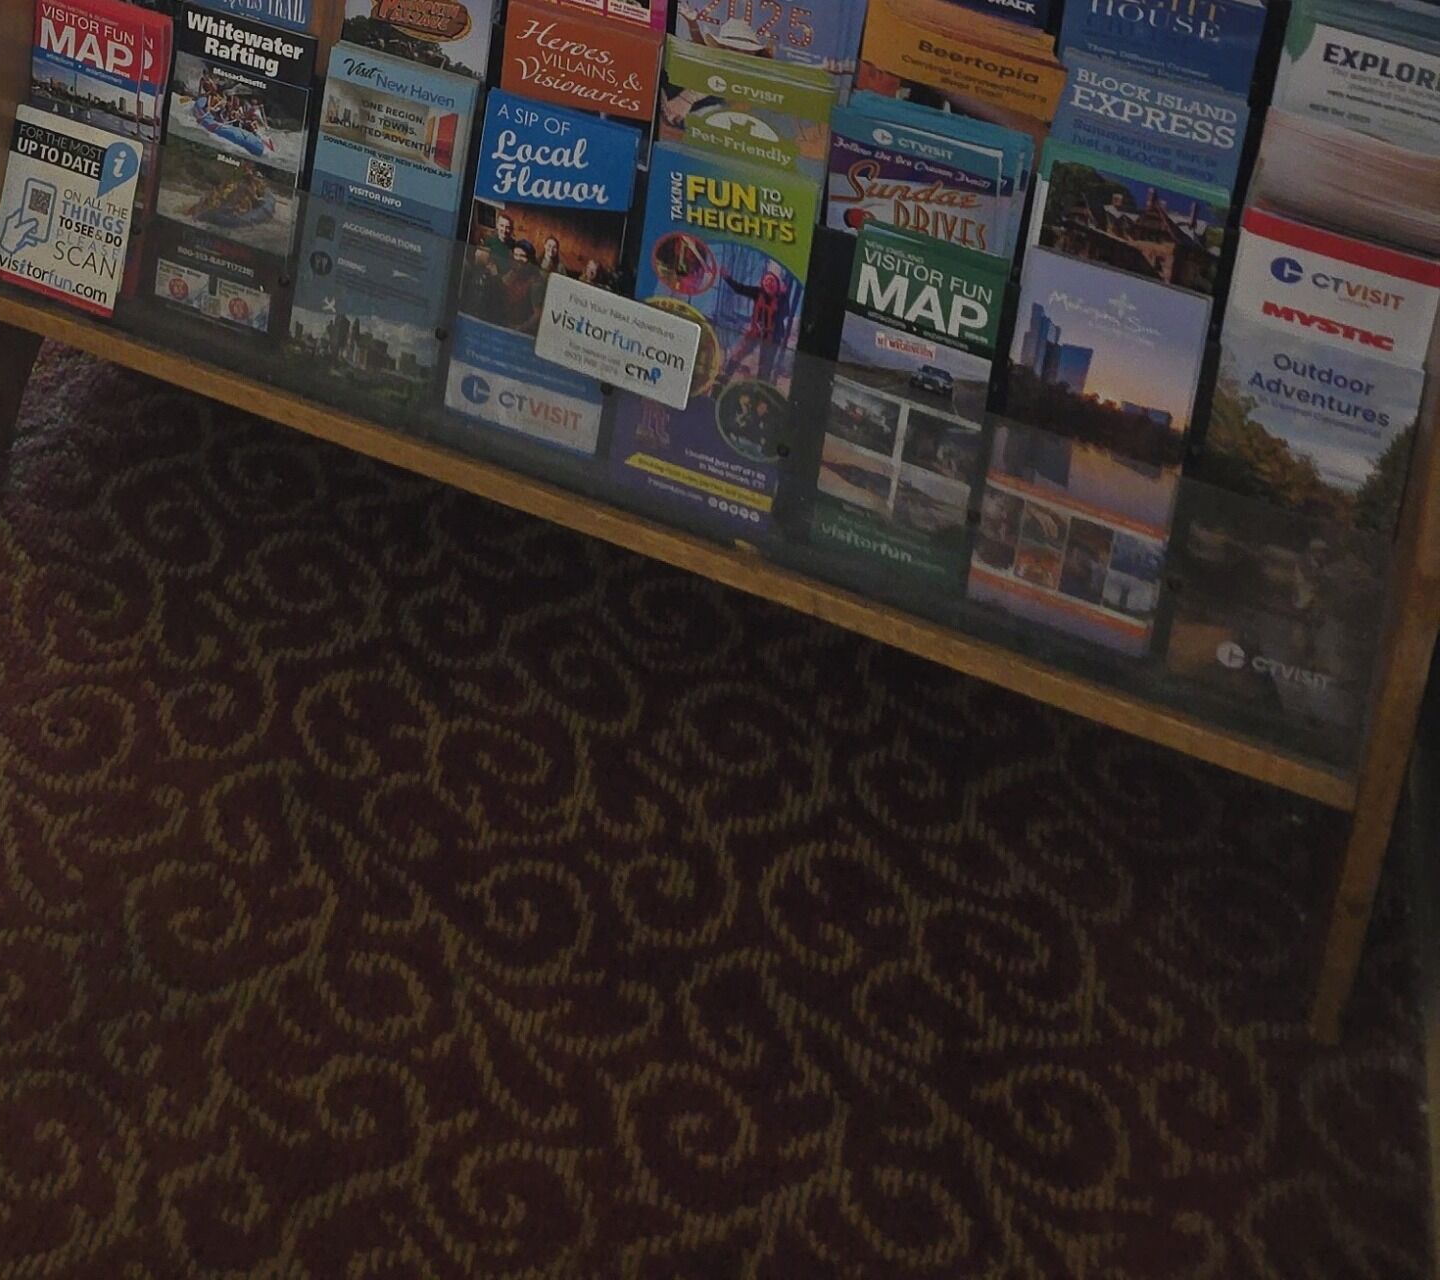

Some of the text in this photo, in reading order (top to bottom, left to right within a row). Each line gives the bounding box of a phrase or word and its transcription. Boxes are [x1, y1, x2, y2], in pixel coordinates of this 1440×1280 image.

[40, 17, 133, 73] MAP
[42, 4, 100, 34] VISITOR
[104, 25, 135, 46] FUN
[186, 10, 304, 62] Whitewater
[516, 18, 615, 65] Heroes,
[204, 37, 280, 78] Rafting
[917, 39, 1039, 84] Beertopia
[514, 56, 641, 113] Visionaries
[1076, 68, 1238, 124] BLOCK ISLAND
[498, 103, 571, 136] A SIP OF
[1070, 84, 1236, 149] EXPRESS
[17, 138, 101, 178] UP TO DATE
[492, 130, 589, 169] Local
[690, 126, 793, 167] Pet-Friendly
[63, 188, 128, 220] ON ALL THE
[349, 185, 402, 208] VISITOR INFO
[492, 162, 609, 205] Flavor
[670, 171, 683, 222] TAKING
[686, 174, 757, 213] FUN
[761, 186, 781, 203] TO
[829, 160, 983, 209] Sundae
[59, 215, 74, 229] TO
[75, 220, 94, 238] SEE
[104, 230, 123, 248] DO
[60, 201, 125, 235] THINGS
[686, 204, 795, 244] HEIGHTS
[760, 202, 794, 220] NEW
[52, 242, 118, 281] SCAN
[864, 248, 992, 305] VISITOR FUN
[856, 262, 988, 338] MAP
[1311, 271, 1406, 312] CTVISIT
[551, 309, 685, 371] visitorfun.com
[1261, 300, 1396, 352] MYSTIC
[1272, 352, 1376, 398] Outdoor
[498, 388, 584, 433] CTVISIT
[1247, 371, 1392, 428] Adventures
